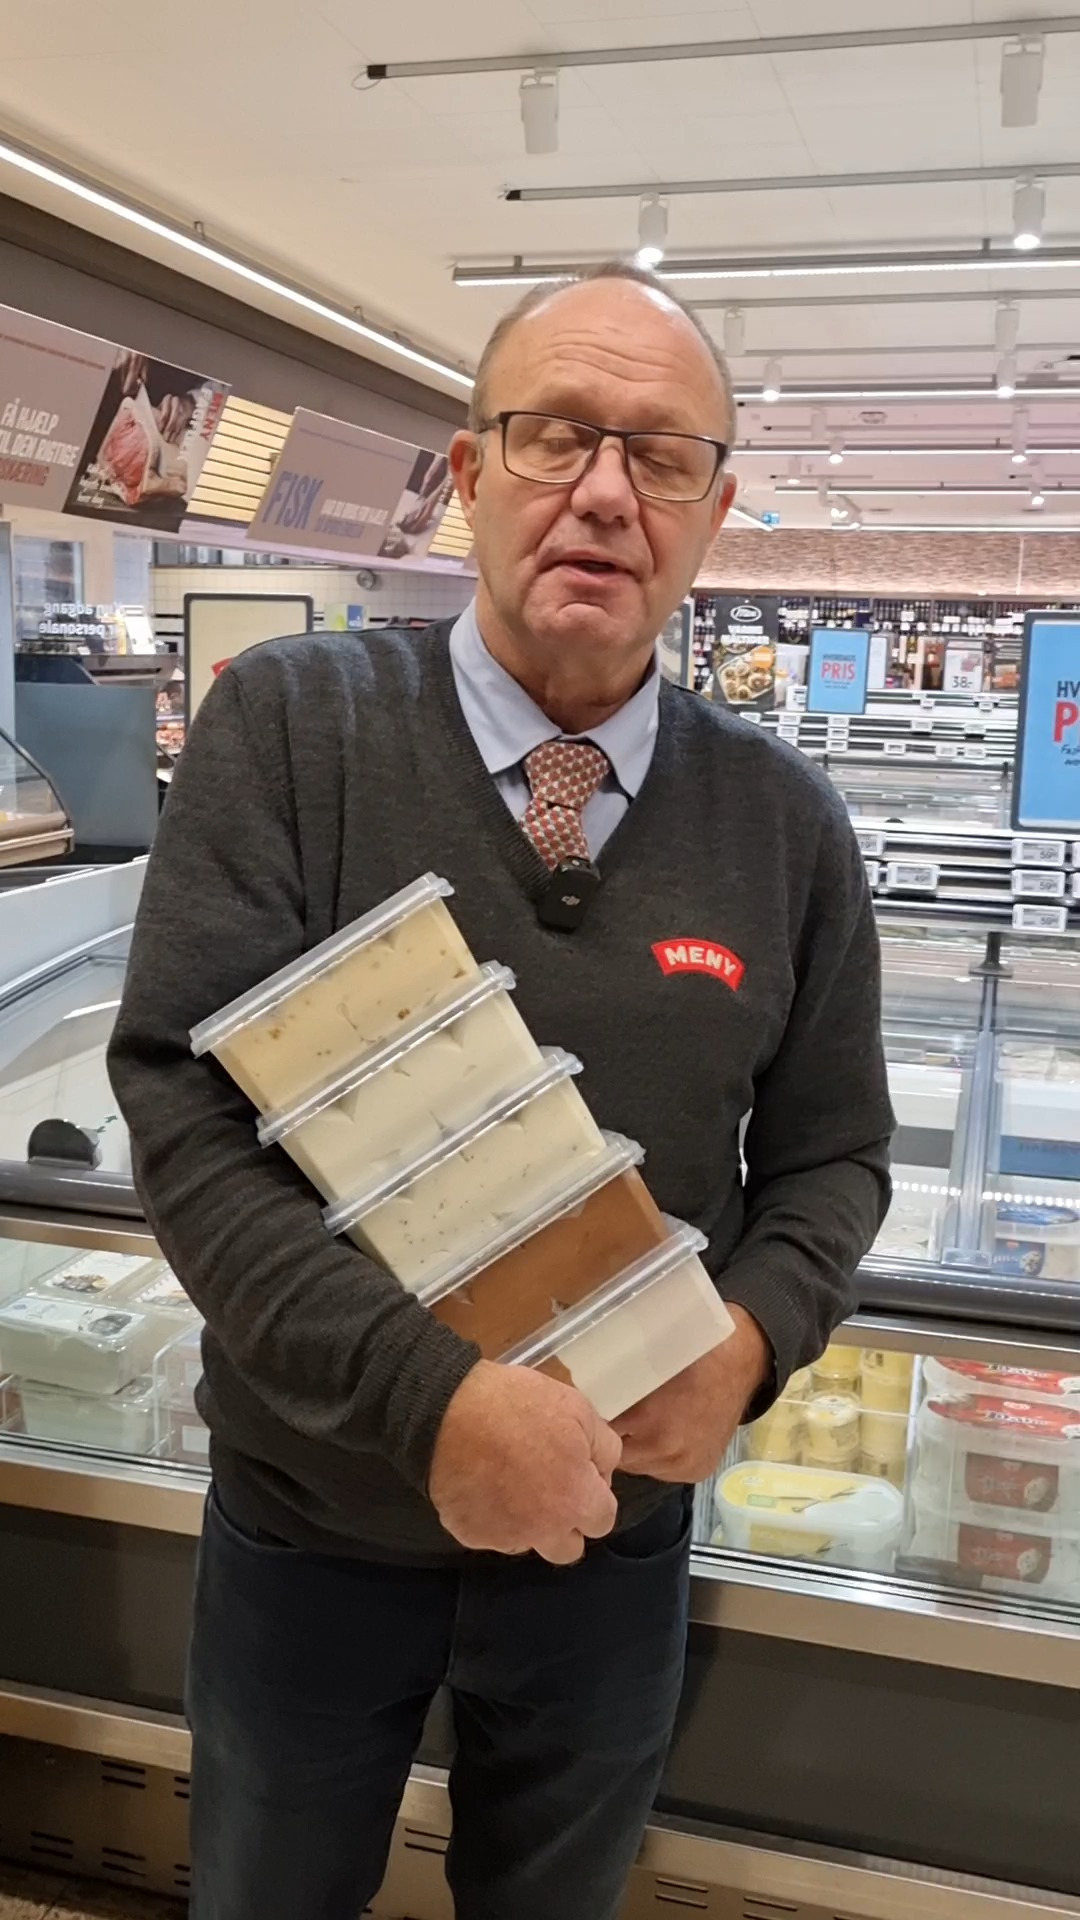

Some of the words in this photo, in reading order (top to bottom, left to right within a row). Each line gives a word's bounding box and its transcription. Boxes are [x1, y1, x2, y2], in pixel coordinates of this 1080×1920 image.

[1, 398, 20, 428] FÅ
[16, 405, 60, 436] HJÆLP
[11, 433, 37, 460] DEN
[35, 439, 81, 468] RIGTIGE
[262, 470, 324, 531] FISK
[821, 661, 856, 681] PRIS
[664, 945, 737, 976] MENY
